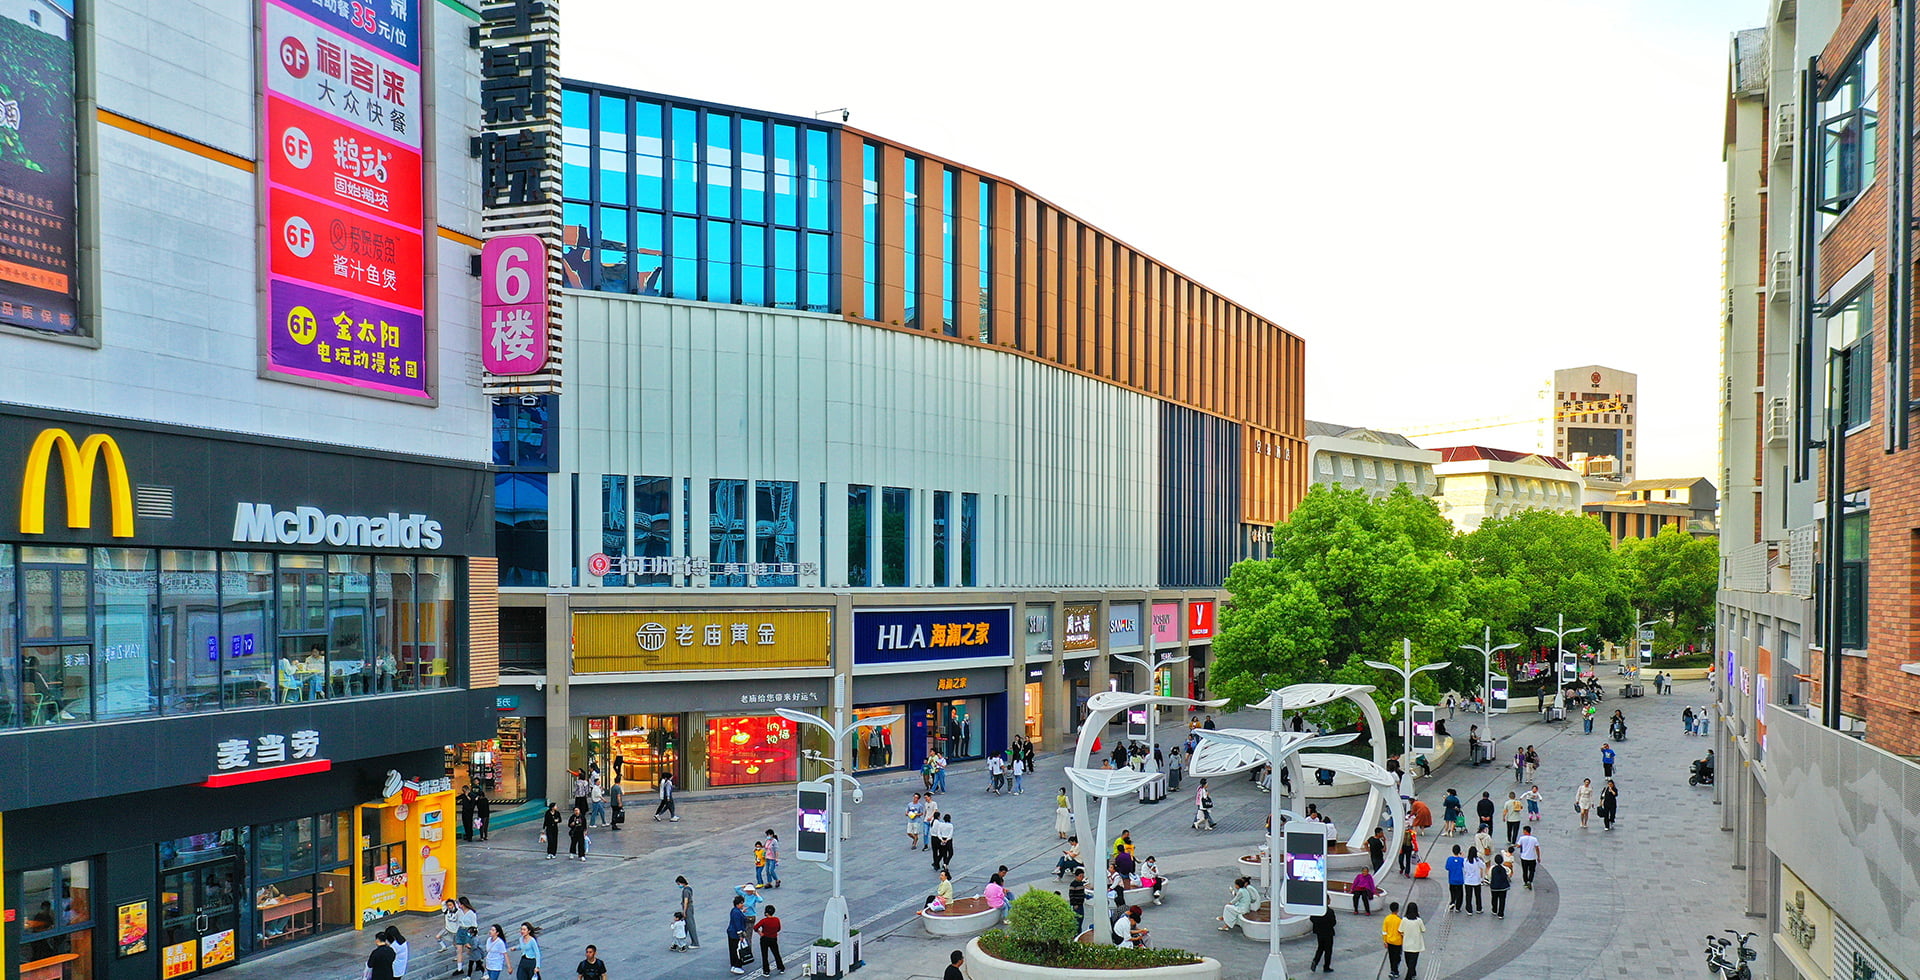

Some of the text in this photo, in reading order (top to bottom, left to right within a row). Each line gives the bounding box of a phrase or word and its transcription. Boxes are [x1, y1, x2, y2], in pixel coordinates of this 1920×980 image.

[282, 43, 307, 70] 6F
[318, 79, 406, 135] 大众快餐
[284, 141, 309, 161] 6F
[287, 224, 312, 249] 6F
[332, 253, 397, 291] 酱汁鱼煲
[491, 246, 535, 362] 6楼
[289, 314, 313, 337] 6F
[333, 310, 400, 348] 金太阳
[317, 341, 418, 379] 电玩动漫乐园
[232, 502, 444, 550] McDonald's
[675, 622, 776, 647] 老庙黄金
[877, 622, 991, 650] HLA 海澜之家
[740, 691, 818, 704] 老庙给您带来好运气
[937, 677, 969, 692] 海澜之家
[217, 729, 320, 770] 麦当劳
